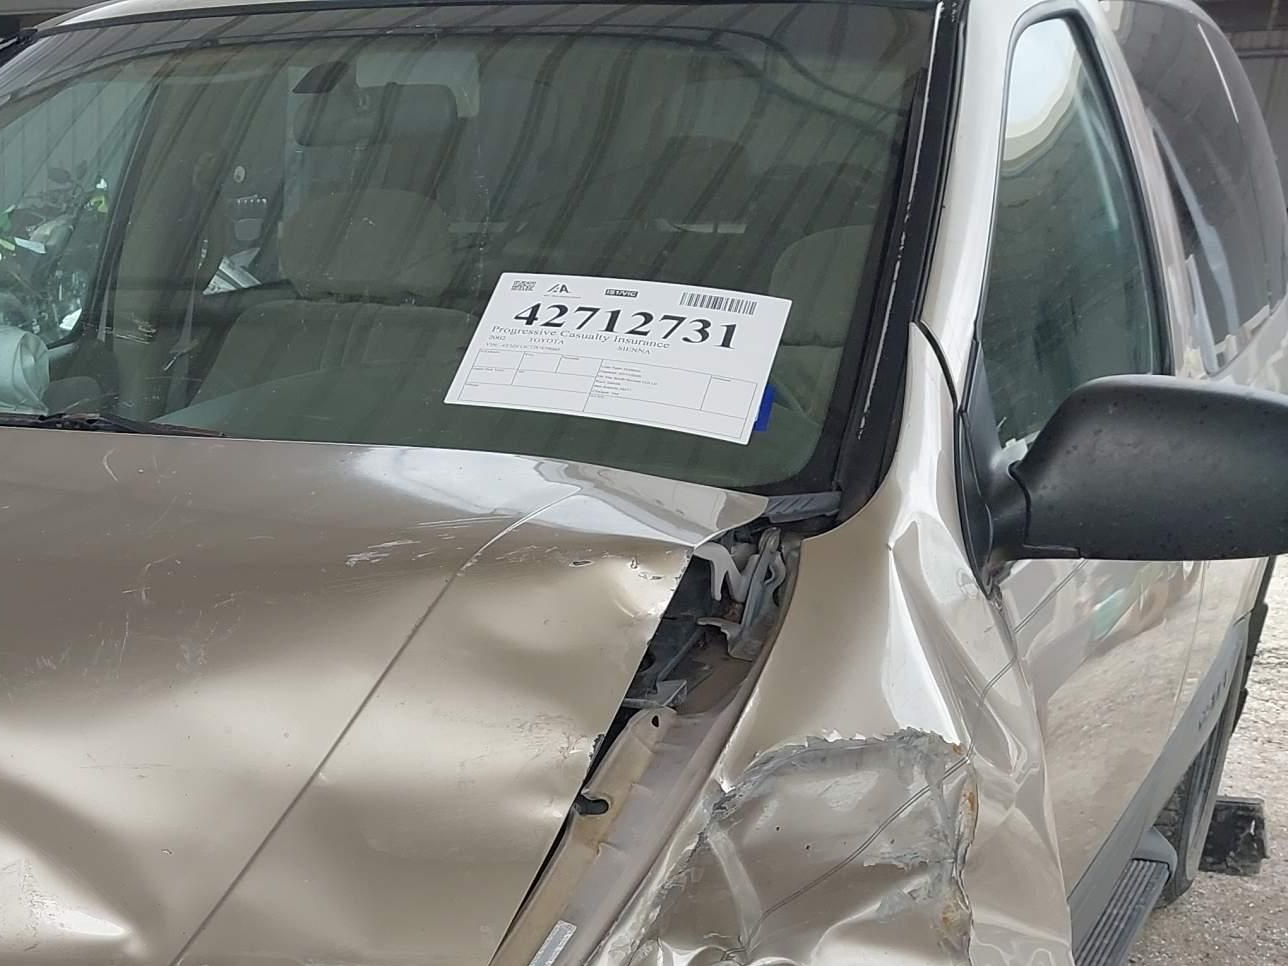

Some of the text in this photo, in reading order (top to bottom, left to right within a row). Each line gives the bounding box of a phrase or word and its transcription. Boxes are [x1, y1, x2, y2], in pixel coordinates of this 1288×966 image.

[491, 325, 671, 349] Progressive Casualty Insurance
[513, 303, 737, 349] 42712731
[528, 337, 565, 345] TOYOTA
[617, 345, 652, 355] SIENNA
